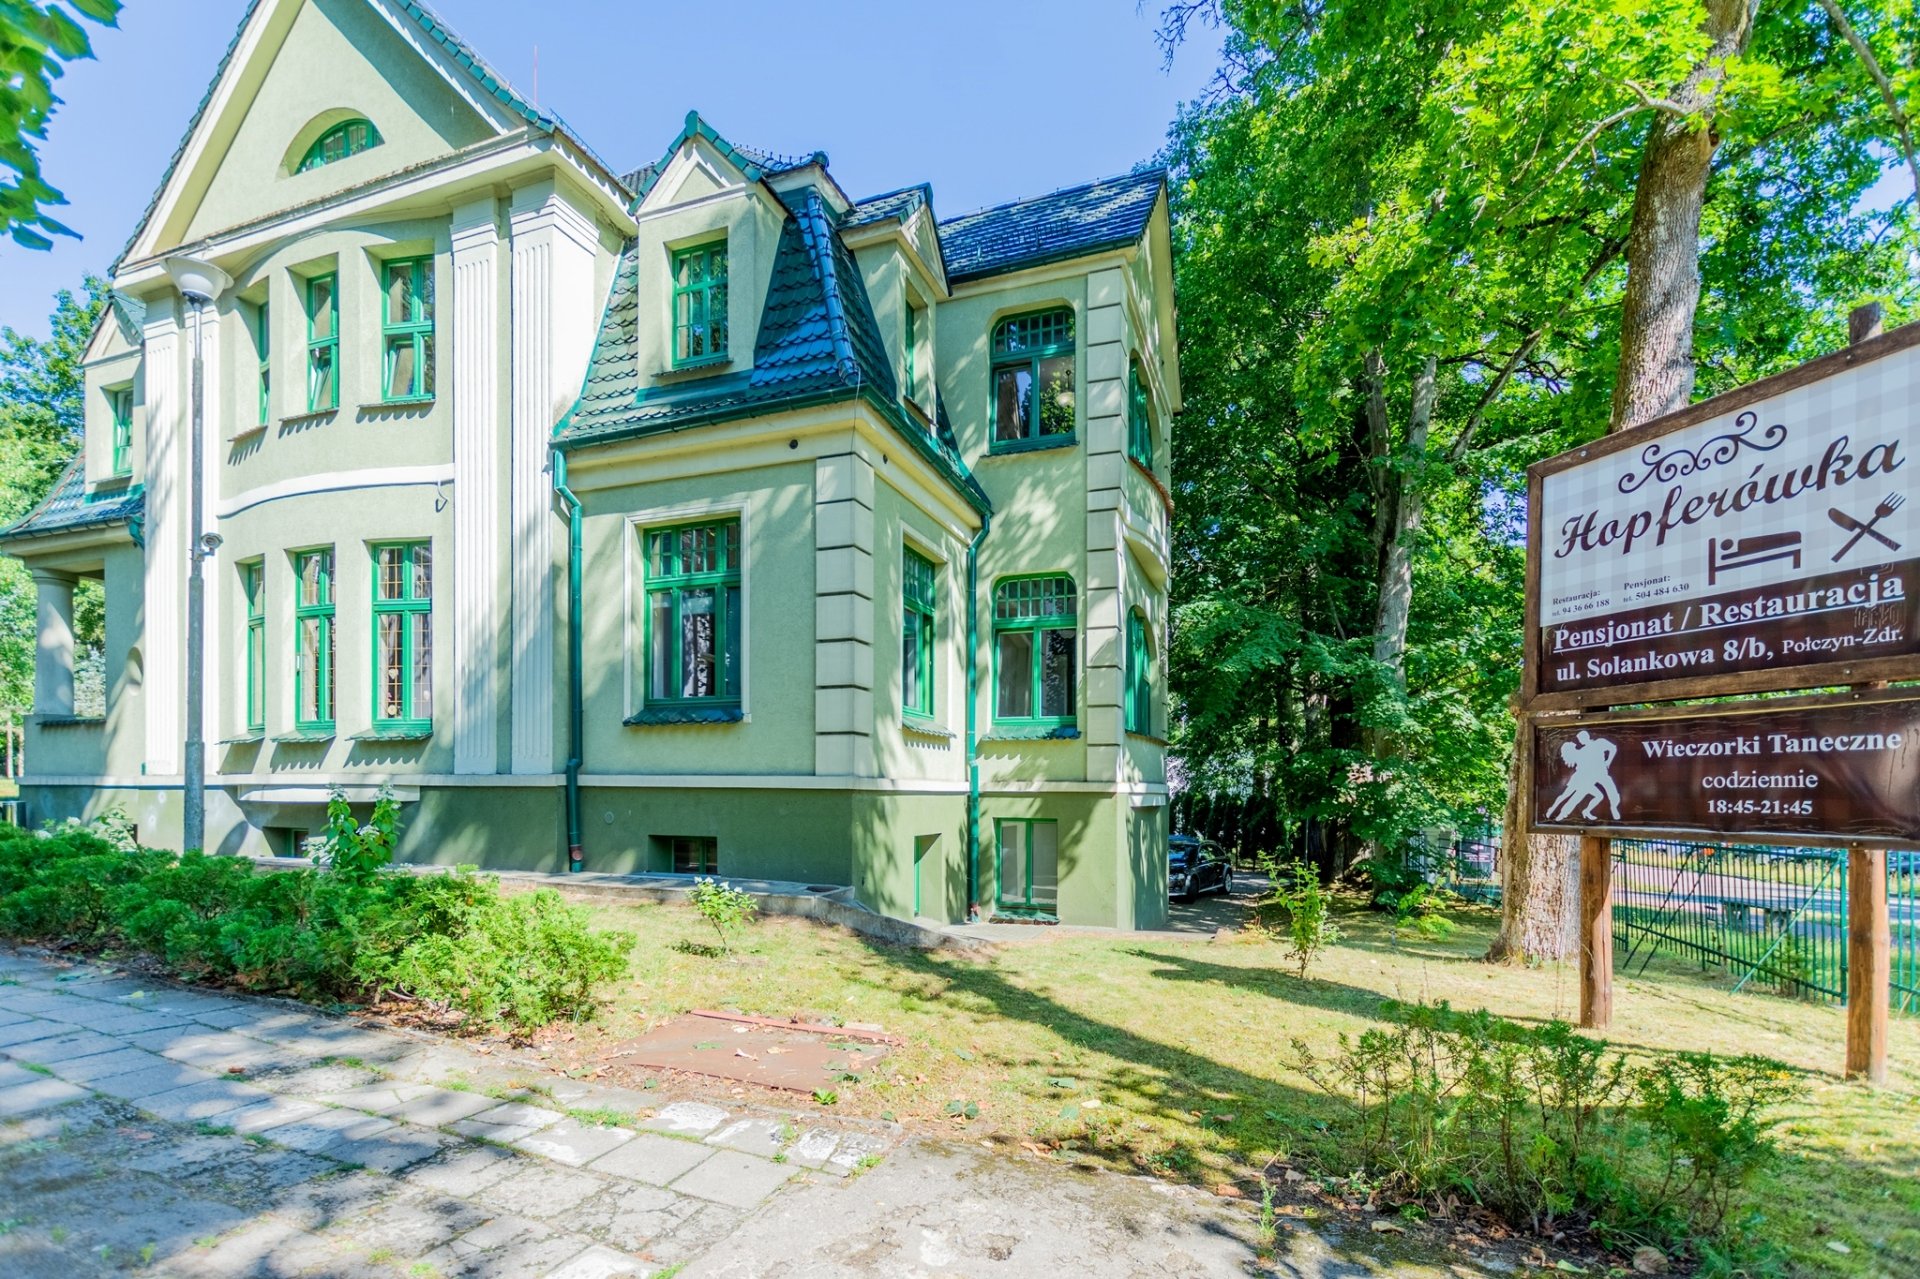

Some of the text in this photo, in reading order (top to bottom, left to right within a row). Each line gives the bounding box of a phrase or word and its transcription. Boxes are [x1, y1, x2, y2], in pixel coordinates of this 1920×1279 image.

[1554, 435, 1905, 558] Hopferówka
[1623, 575, 1671, 590] Pensjonat:
[1636, 591, 1651, 600] 504
[1653, 586, 1670, 597] 484
[1672, 583, 1690, 592] 630
[1552, 590, 1601, 605] Restauracja:
[1573, 605, 1582, 613] 36
[1596, 599, 1610, 608] 188
[1554, 612, 1674, 650] Pensjonat
[1699, 573, 1905, 627] Restauracja
[1556, 627, 1903, 681] ul. Solankowa 8/b, Połczyn-Zdr.
[1642, 733, 1902, 758] Wieczorki Taneczne
[1702, 770, 1818, 789] codziennie
[1707, 799, 1813, 815] 18:45-21:45
